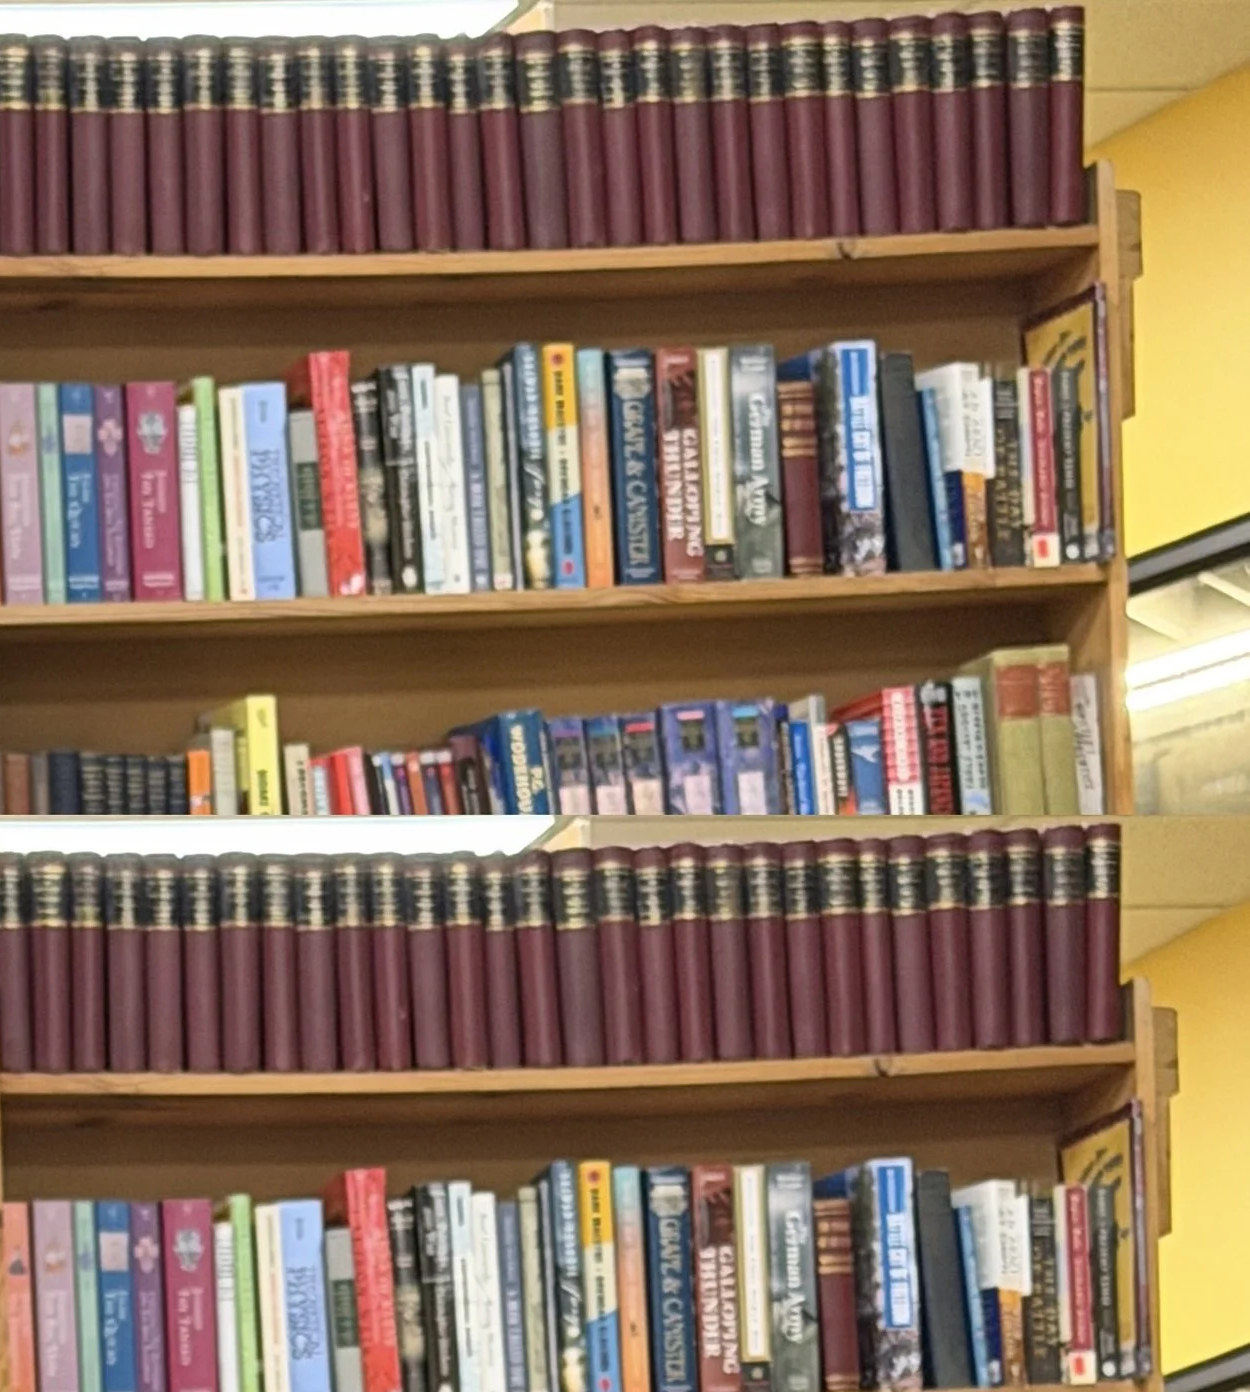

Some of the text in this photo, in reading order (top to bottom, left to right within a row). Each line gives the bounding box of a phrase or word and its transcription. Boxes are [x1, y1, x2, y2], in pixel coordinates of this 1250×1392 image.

[622, 401, 651, 565] GRAPE & CANISTER
[664, 429, 684, 541] THUNDER
[683, 429, 703, 557] GALLOPING
[747, 393, 770, 527] German Army
[658, 1218, 687, 1382] GRAPE & CANISTER
[700, 1246, 720, 1358] THUNDER
[719, 1246, 739, 1374] GALLOPING
[783, 1210, 806, 1344] German Army
